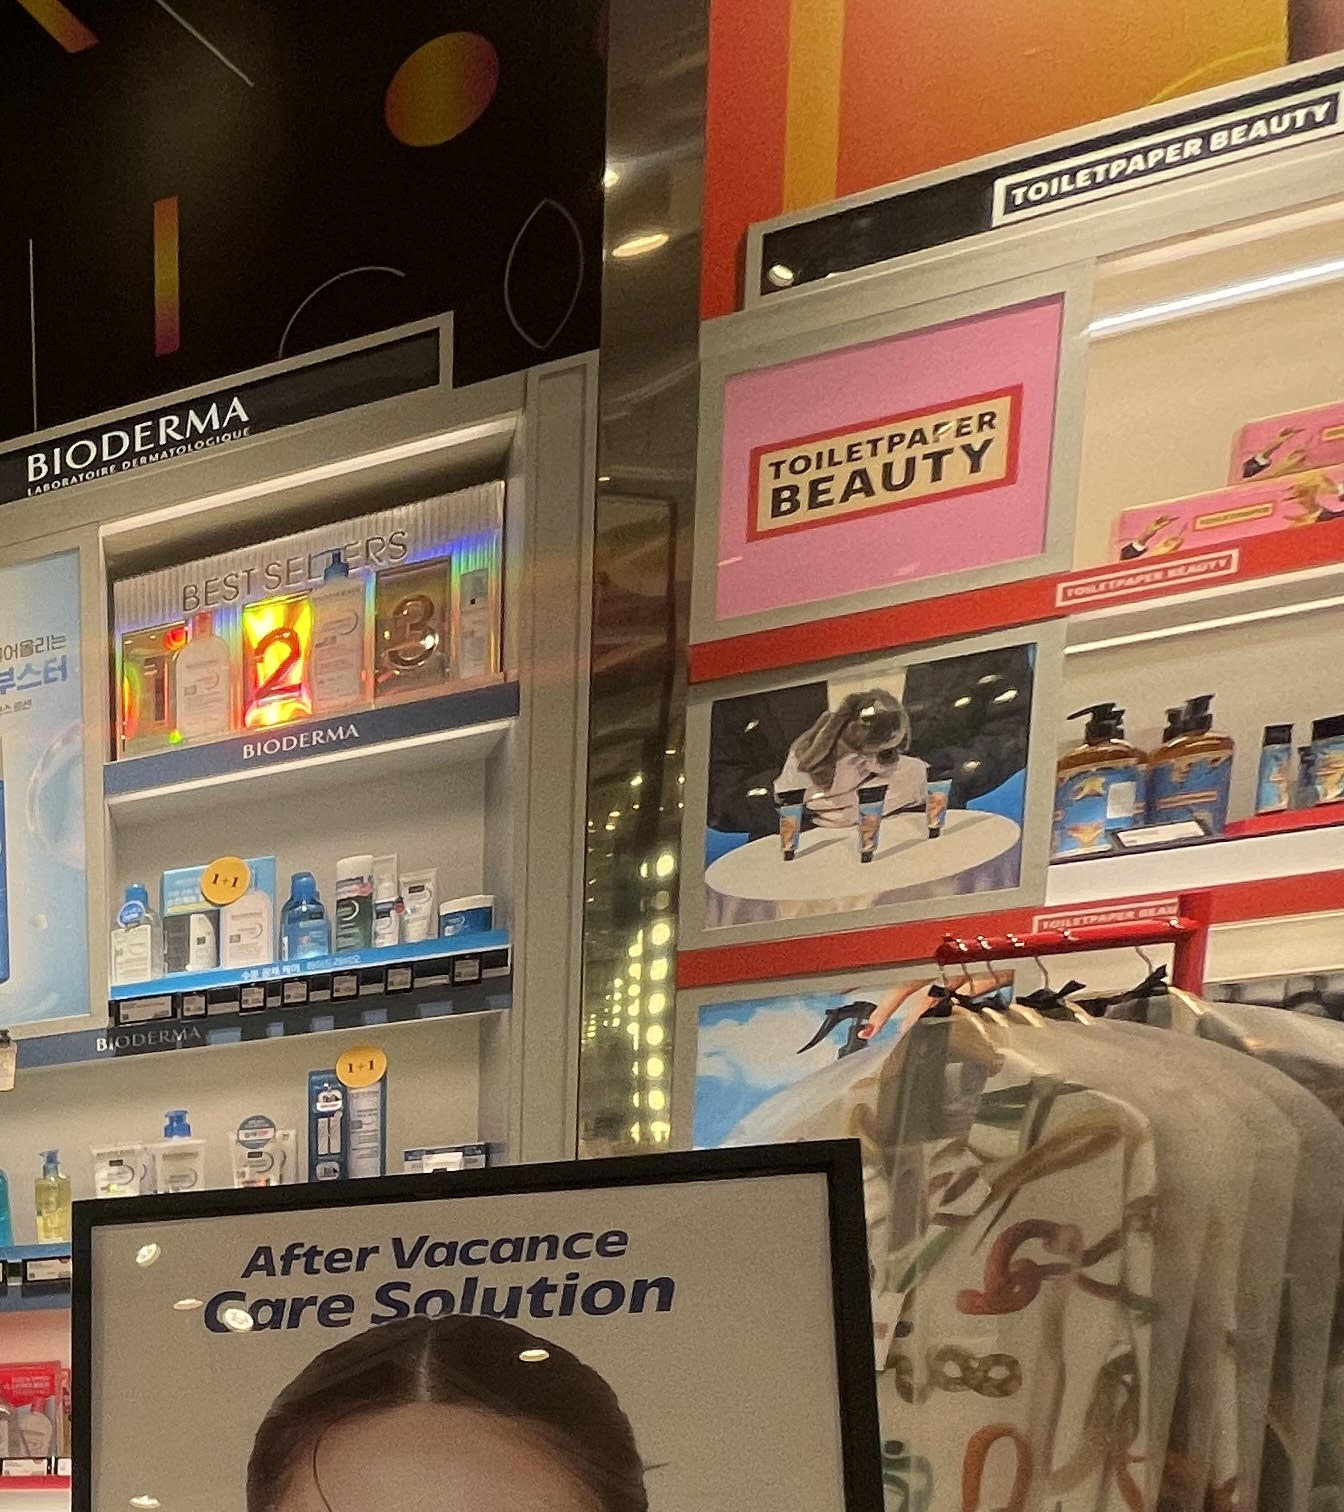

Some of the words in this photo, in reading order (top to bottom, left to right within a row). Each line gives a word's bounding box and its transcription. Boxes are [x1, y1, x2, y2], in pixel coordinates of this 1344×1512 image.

[1012, 138, 1203, 205] TOILETPAPER
[1209, 102, 1331, 152] BEAUTY
[26, 396, 250, 483] BIODERMA
[27, 464, 117, 498] LABORATOIRE
[121, 427, 251, 471] DERMATOLOGIQUE
[768, 411, 998, 480] TOILETPAPER
[770, 437, 995, 519] BEAUTY
[182, 568, 256, 613] BEST
[264, 531, 408, 591] SELERS
[1066, 571, 1165, 598] TOILETPAPER
[1167, 557, 1230, 580] BEAUTY
[255, 628, 303, 700] 2
[387, 594, 439, 670] 3
[242, 723, 360, 760] BIODERMA
[211, 873, 240, 888] 1+1
[95, 1025, 202, 1053] BIODERMA
[346, 1058, 376, 1075] 1+1
[240, 1242, 380, 1279] After
[391, 1229, 630, 1269] Vacance
[202, 1290, 356, 1334] Care
[369, 1272, 676, 1324] Solution
